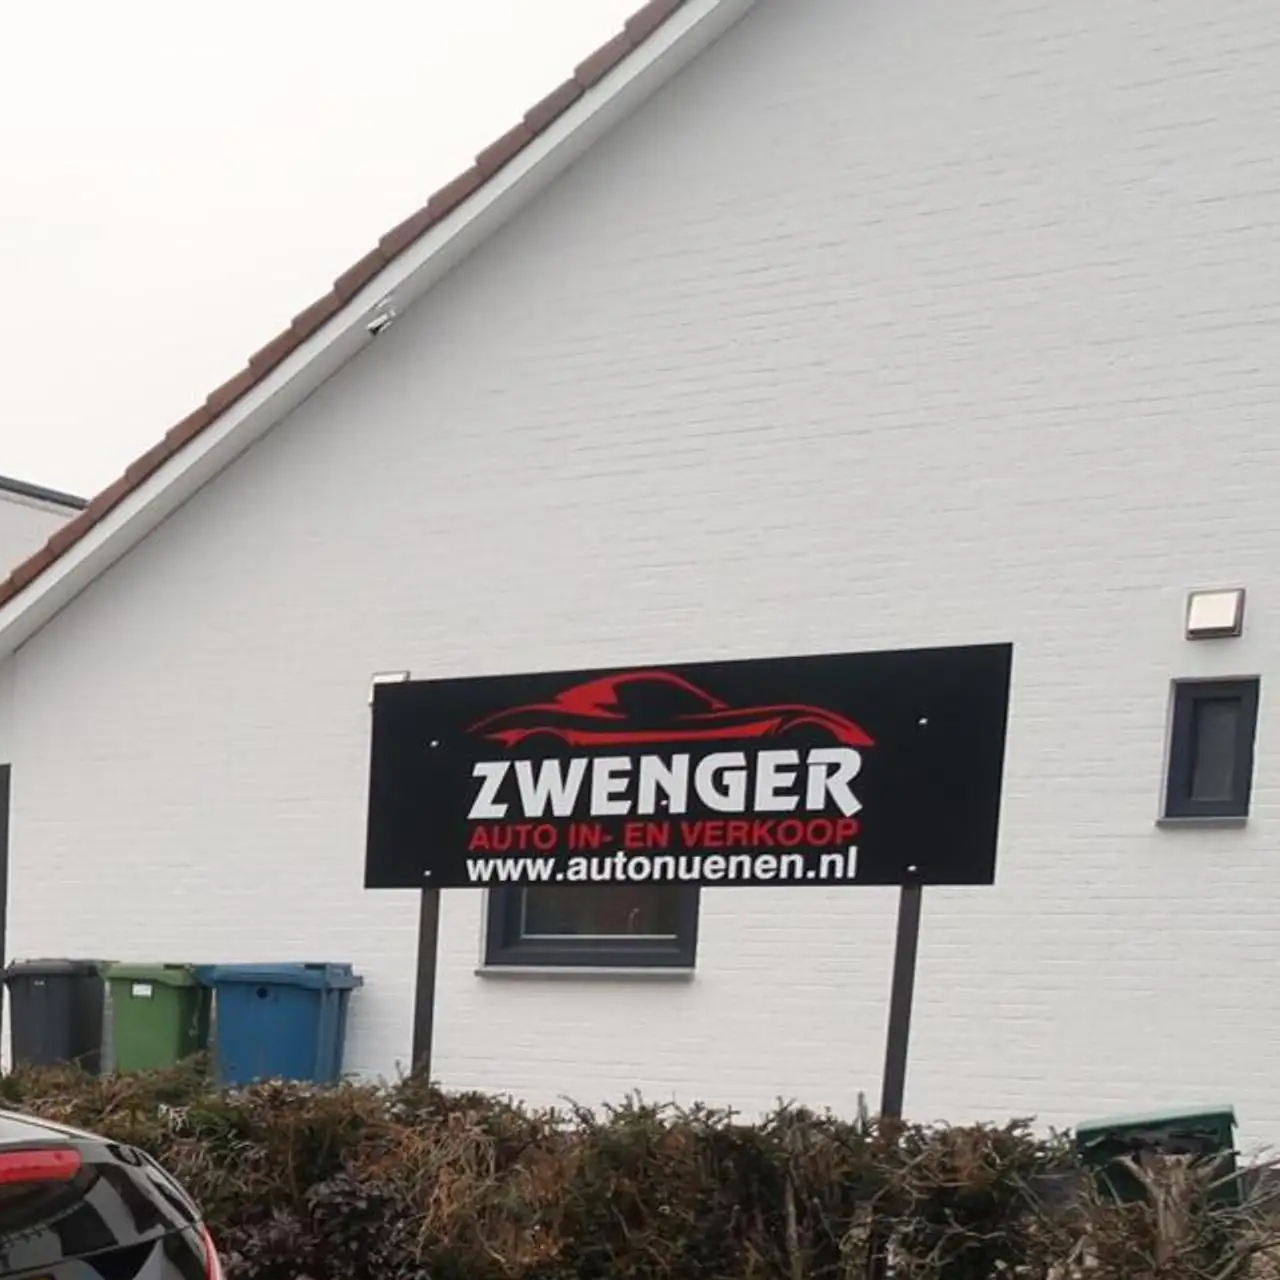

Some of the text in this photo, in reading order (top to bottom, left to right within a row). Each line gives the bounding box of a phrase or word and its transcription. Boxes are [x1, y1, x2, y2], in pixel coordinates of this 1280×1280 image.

[467, 747, 863, 821] ZWENGER
[468, 818, 859, 851] AUTO IN- EN VERKOOP
[466, 845, 858, 882] www.autonuenen.nl
